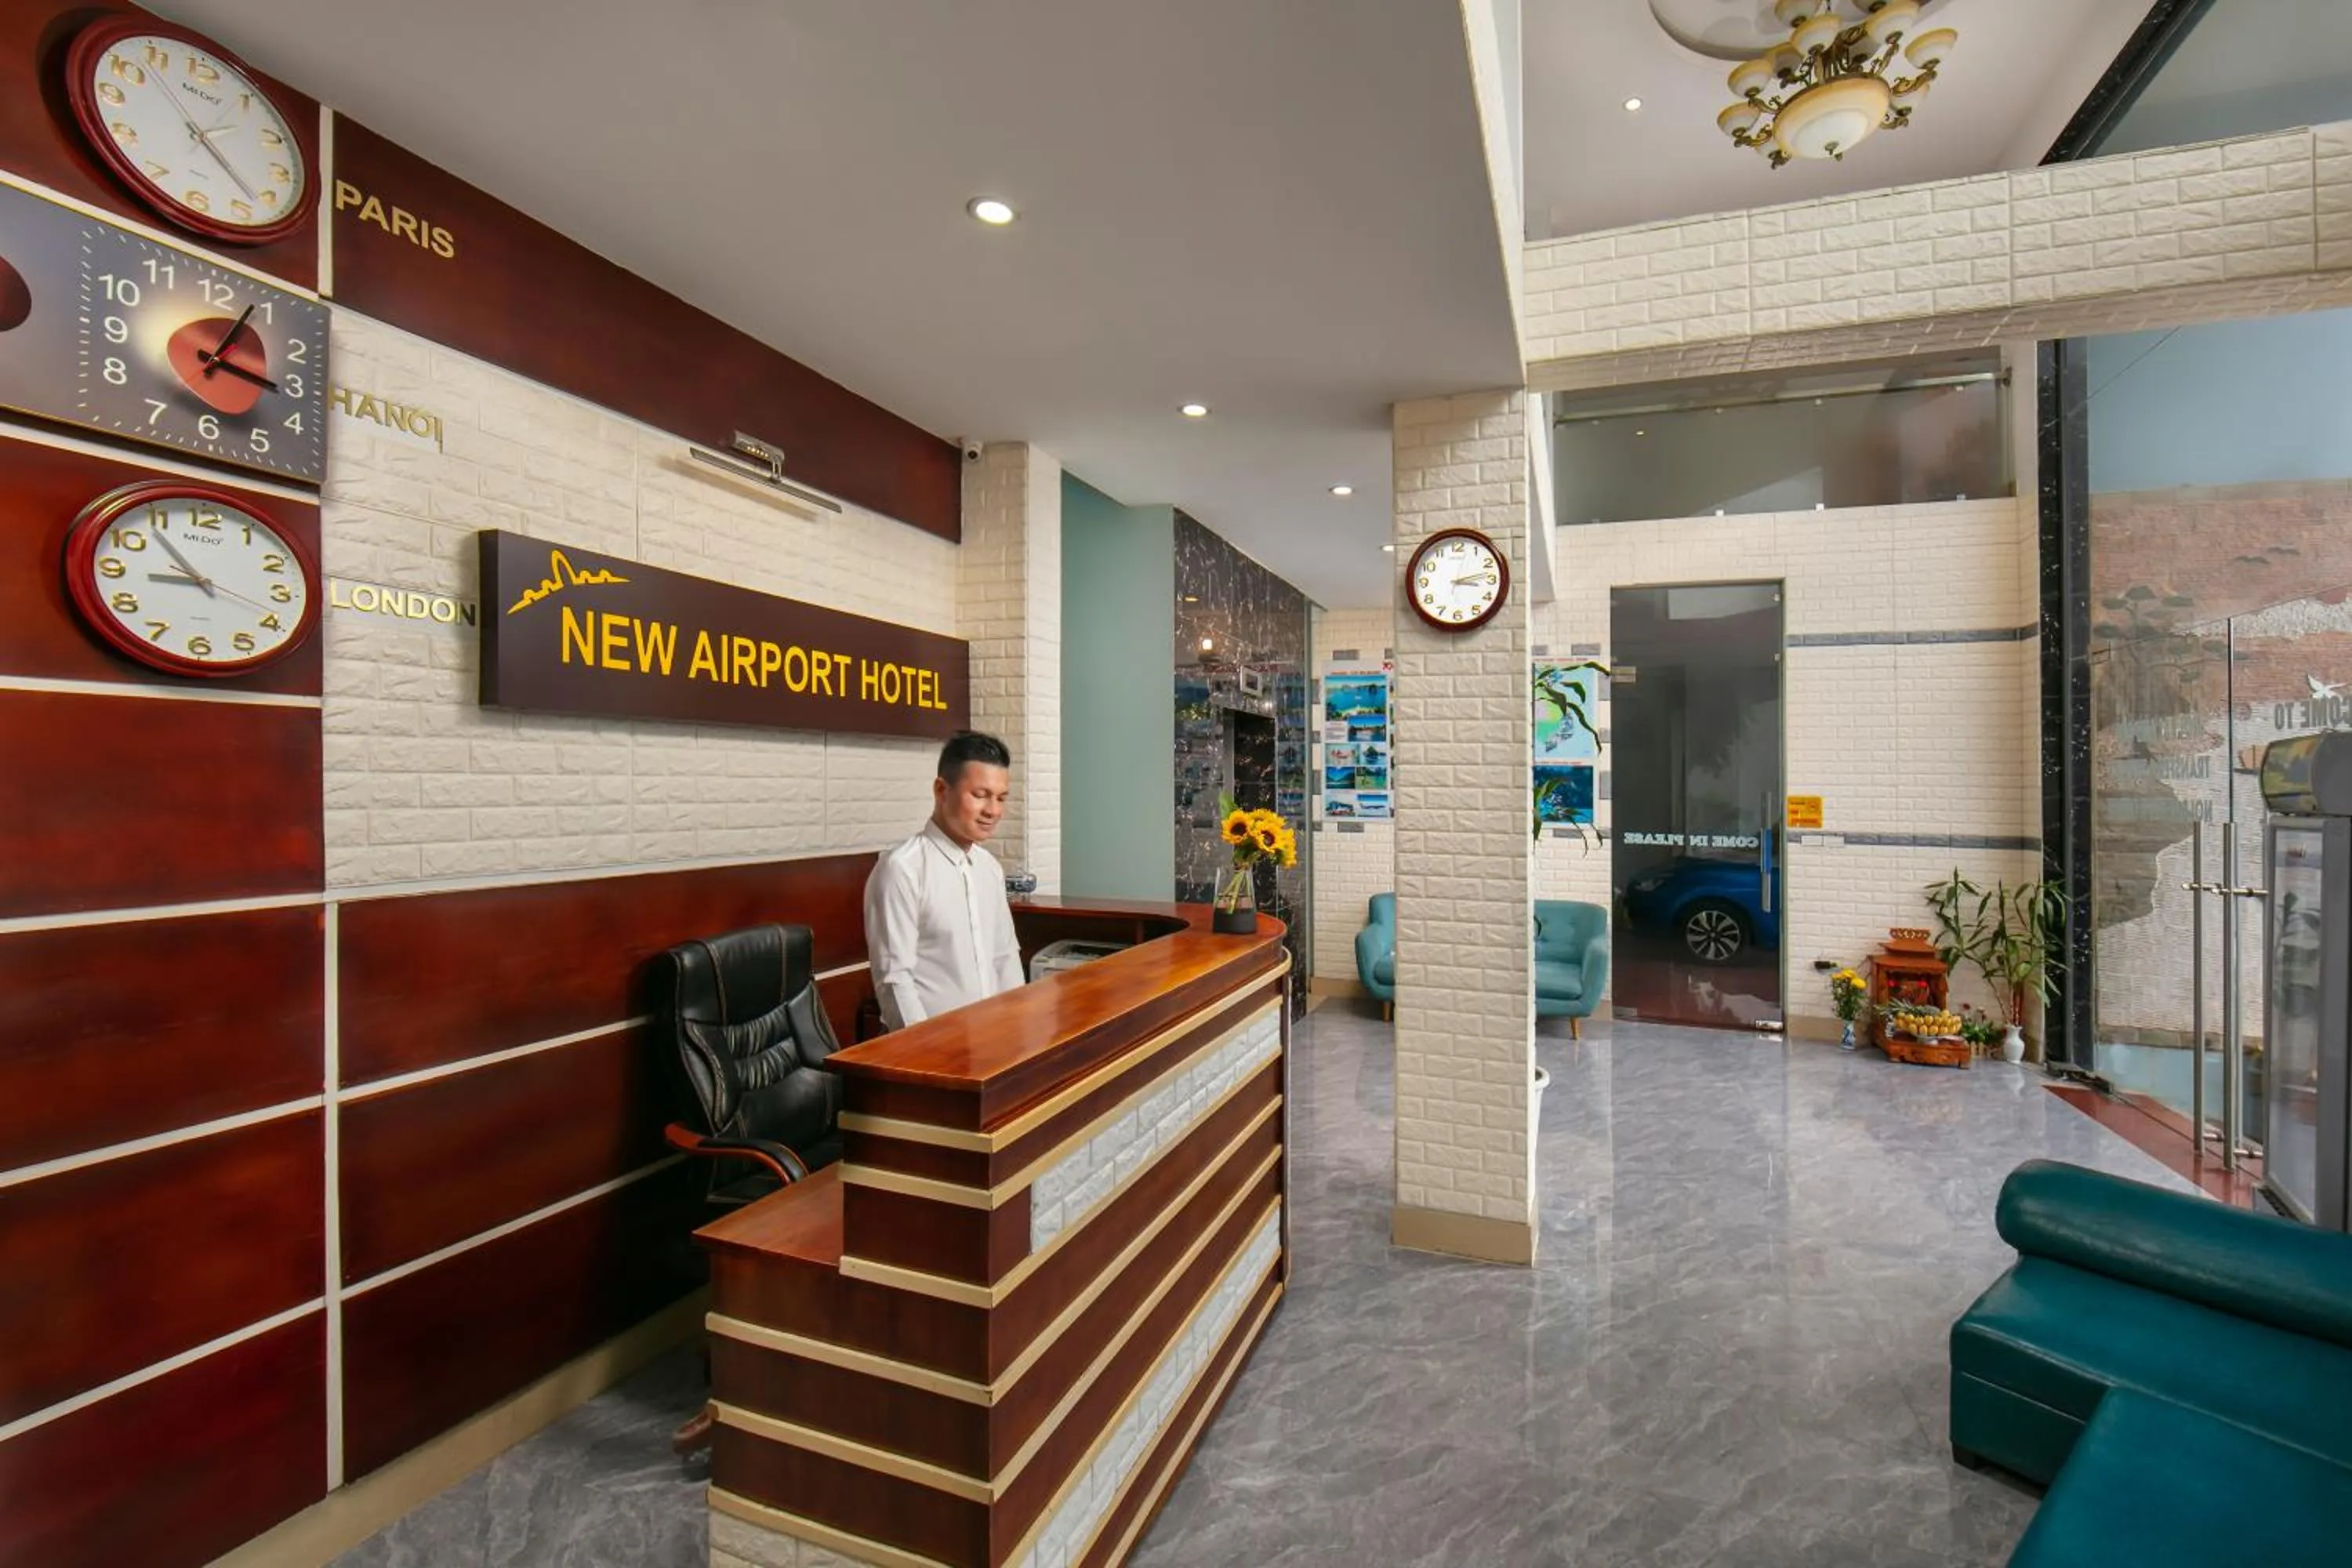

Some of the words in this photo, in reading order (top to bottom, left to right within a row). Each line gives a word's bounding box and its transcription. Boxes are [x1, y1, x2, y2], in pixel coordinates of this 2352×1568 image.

[336, 179, 454, 258] PARIS
[143, 259, 174, 289] 11
[99, 274, 140, 307] 10
[198, 279, 234, 311] 12
[260, 303, 272, 325] 1
[103, 316, 128, 343] 9
[287, 339, 307, 364] 2
[103, 357, 127, 385] 8
[285, 375, 303, 397] 3
[144, 398, 168, 425] 7
[328, 382, 443, 452] HANOI
[198, 415, 220, 440] 6
[284, 413, 304, 435] 4
[250, 428, 270, 452] 5
[147, 509, 168, 530] 11
[188, 509, 222, 530] 12
[111, 529, 147, 551] 10
[242, 526, 252, 546] 1
[1451, 542, 1465, 552] 12
[99, 557, 125, 578] 9
[263, 554, 285, 574] 2
[1423, 561, 1436, 572] 10
[1483, 557, 1493, 568] 2
[1418, 576, 1428, 588] 9
[1486, 574, 1497, 585] 3
[113, 593, 138, 613] 8
[270, 584, 291, 603] 3
[329, 577, 476, 626] LONDON
[1424, 593, 1434, 604] 8
[1482, 592, 1492, 601] 4
[1436, 605, 1446, 615] 7
[1453, 610, 1463, 621] 6
[1472, 605, 1480, 615] 5
[145, 621, 170, 641] 7
[259, 614, 279, 631] 4
[187, 637, 212, 655] 6
[233, 633, 255, 652] 5
[561, 606, 677, 676] NEW
[688, 630, 852, 698] AIRPORT
[862, 658, 947, 710] HOTEL
